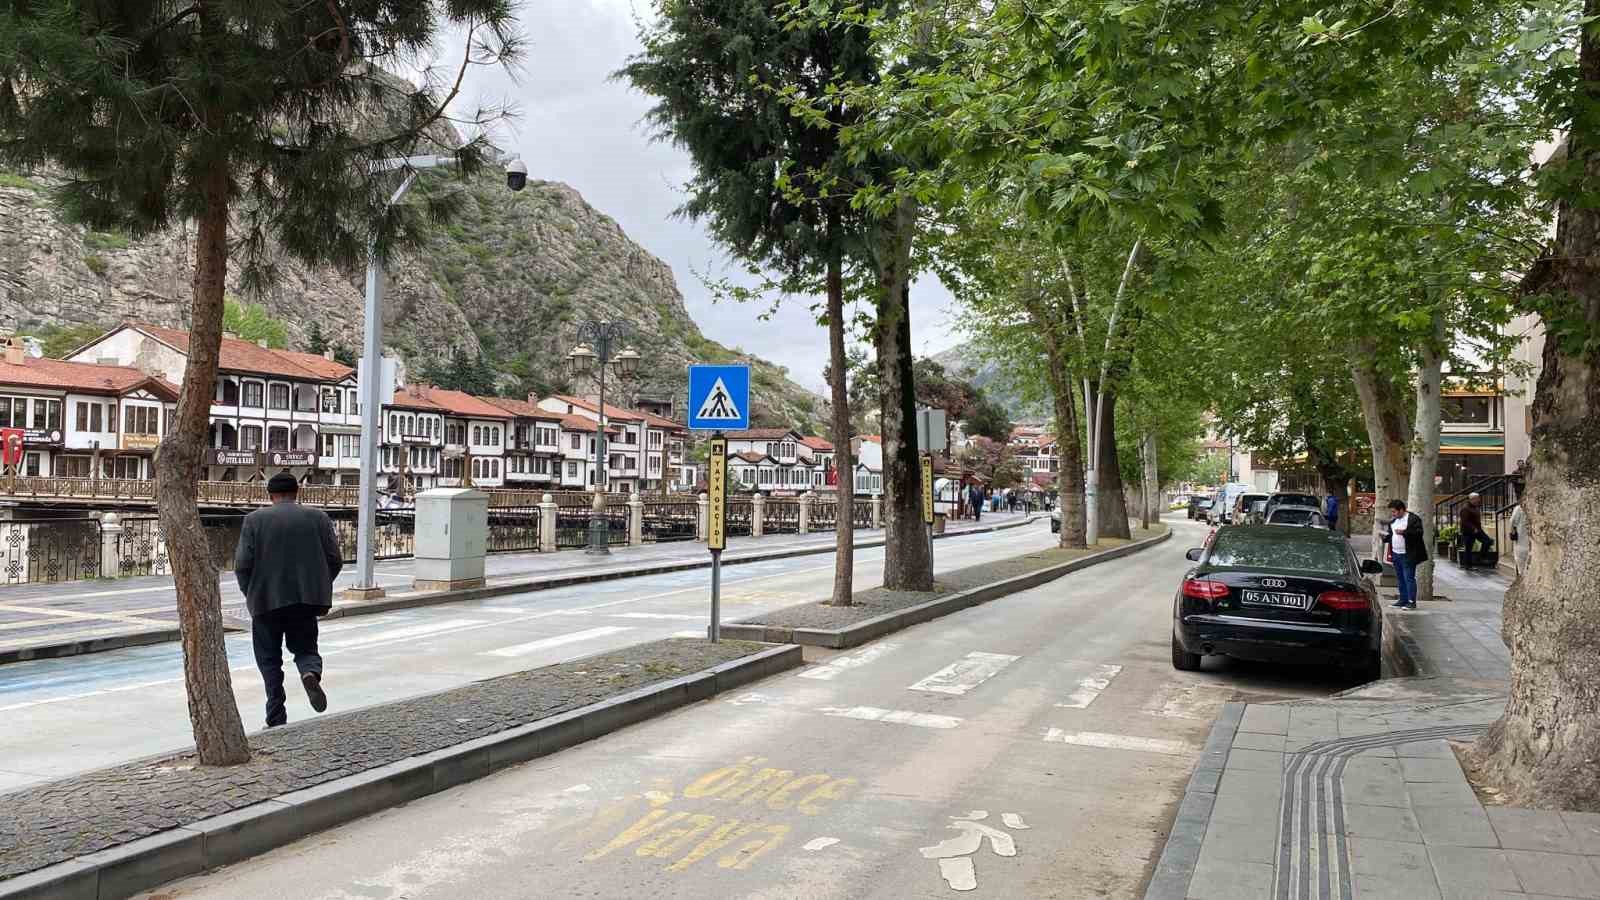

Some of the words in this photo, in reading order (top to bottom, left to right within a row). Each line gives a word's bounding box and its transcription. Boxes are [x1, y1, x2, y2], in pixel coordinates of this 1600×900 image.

[1247, 592, 1260, 602] 05
[1262, 594, 1281, 604] AN
[1283, 596, 1302, 606] 001
